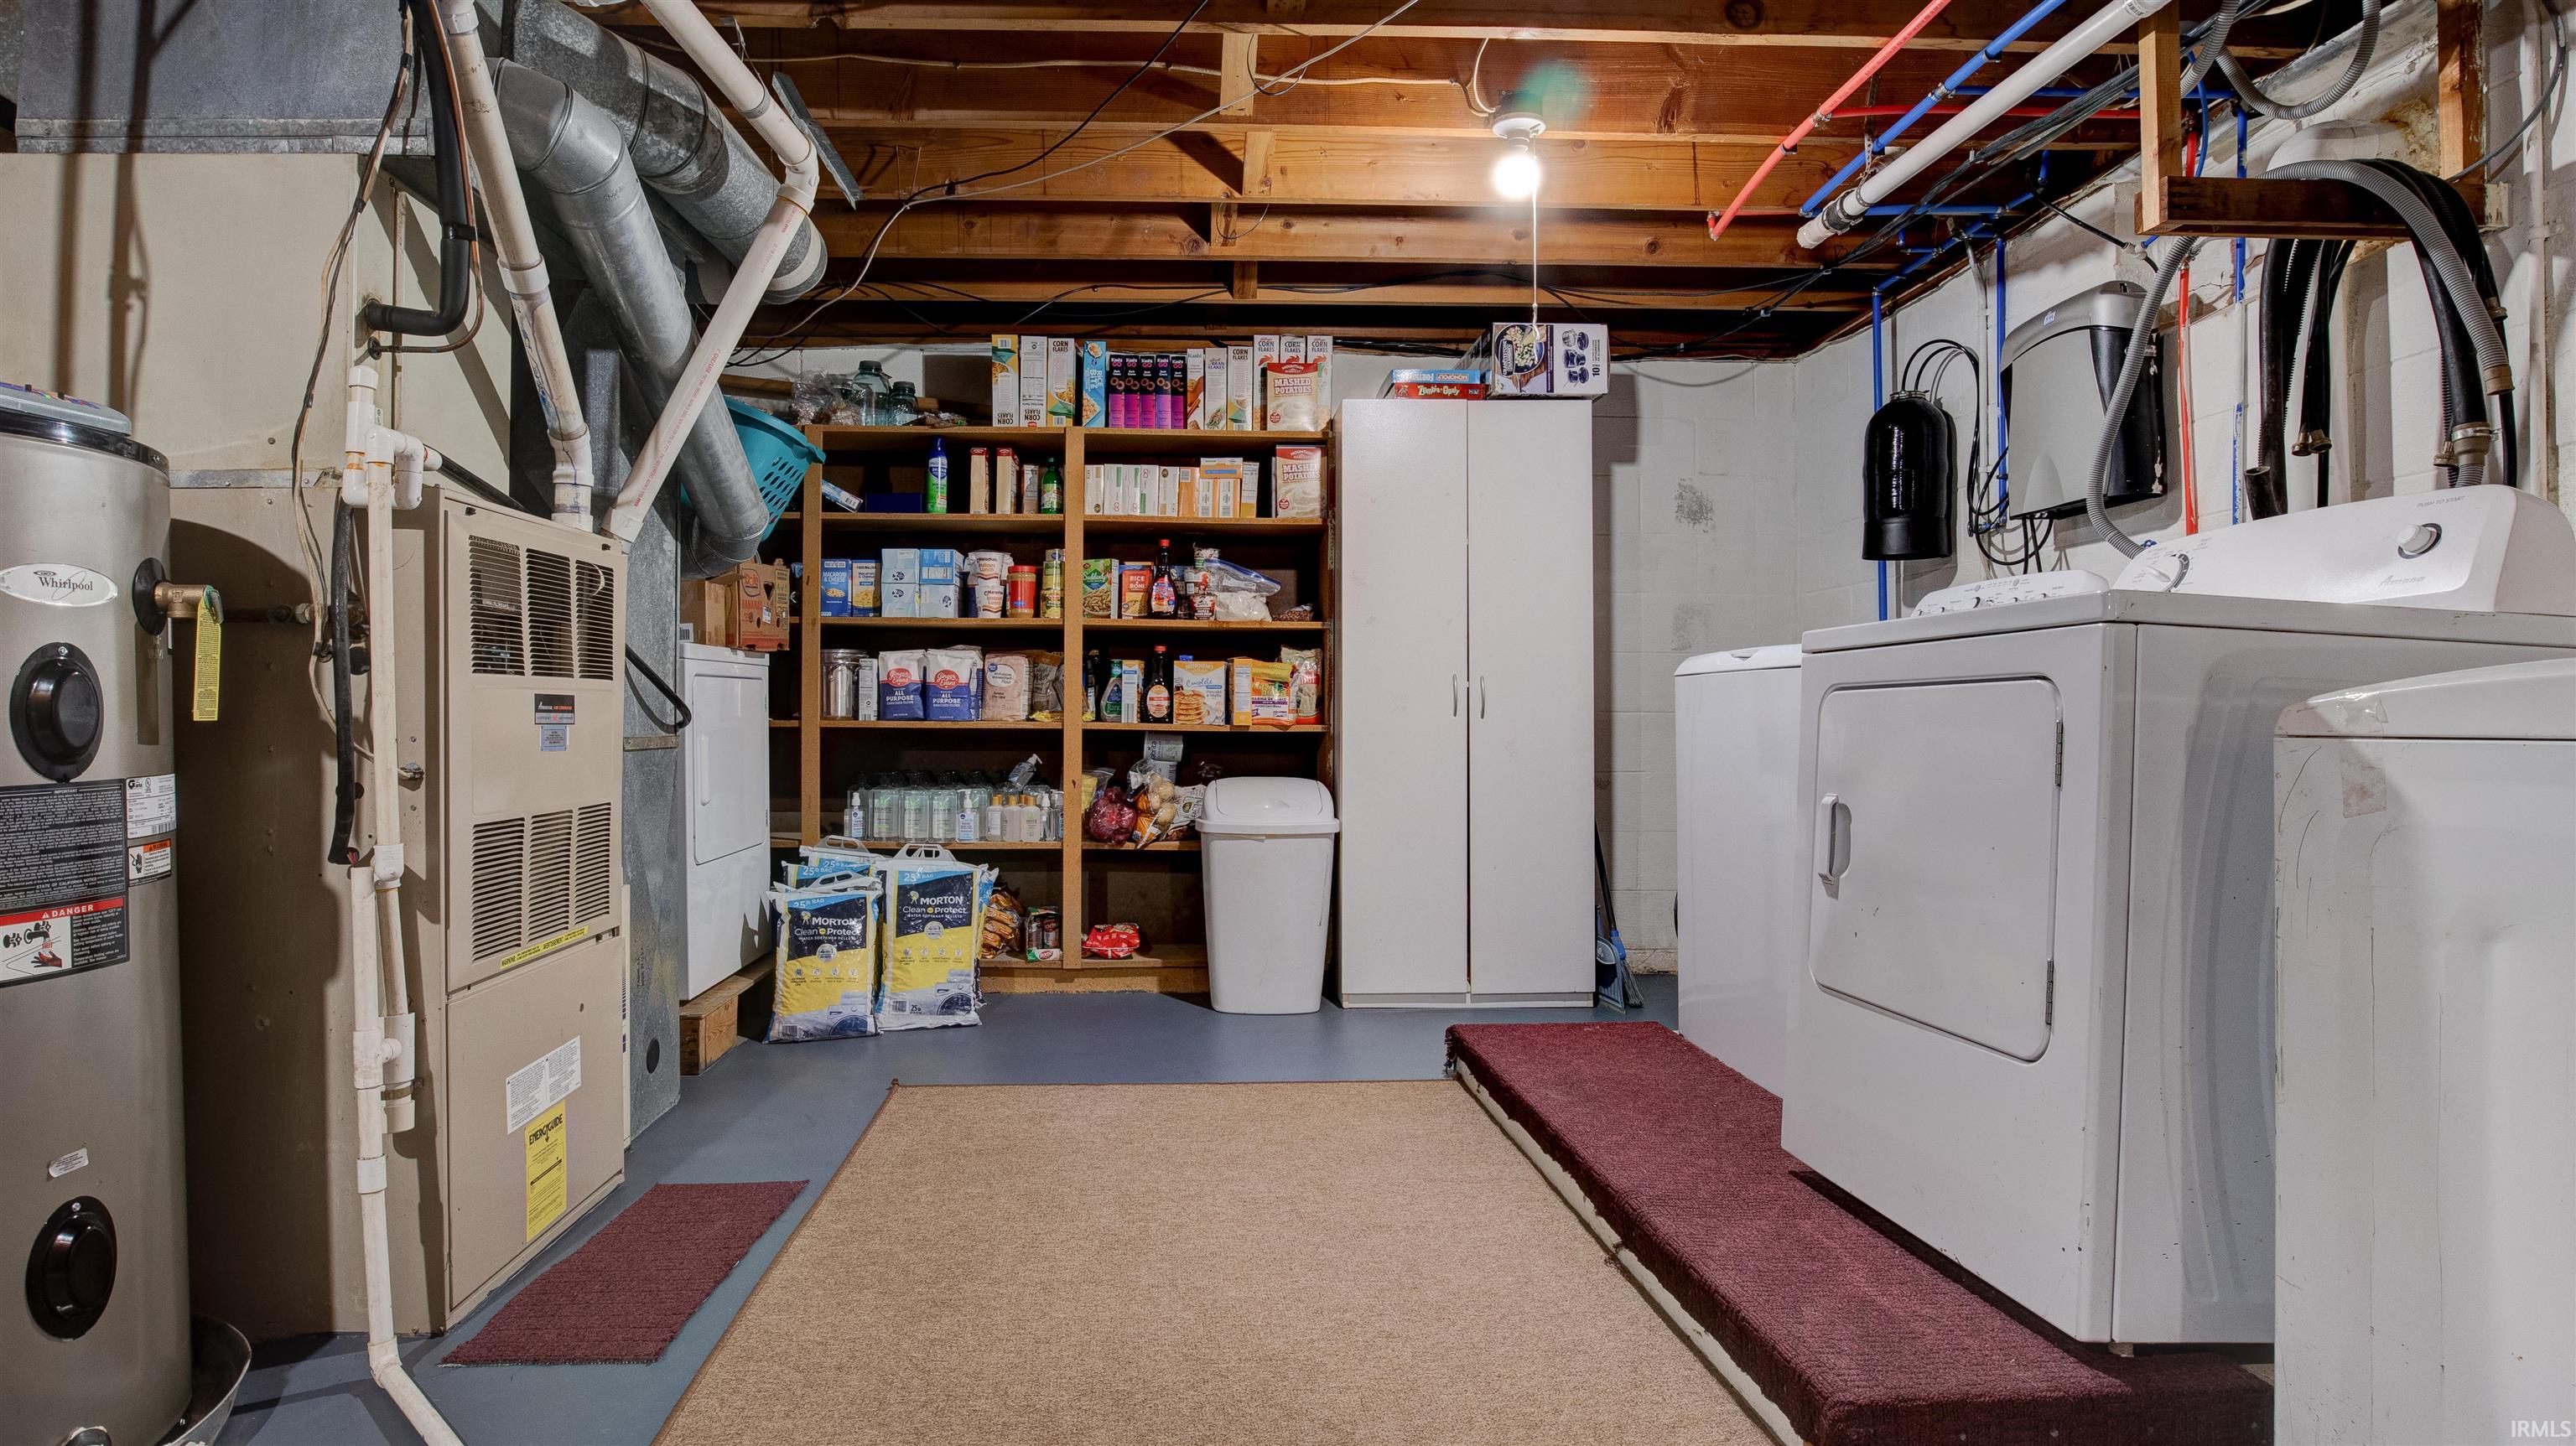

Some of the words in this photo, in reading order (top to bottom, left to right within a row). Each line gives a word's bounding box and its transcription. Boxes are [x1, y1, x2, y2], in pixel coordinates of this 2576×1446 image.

[1592, 367, 1600, 377] 10
[1275, 377, 1311, 386] MASHED
[1282, 463, 1320, 472] MASHED
[1283, 472, 1321, 480] POTATOES
[2445, 495, 2465, 504] START
[39, 576, 93, 592] Whirlpool
[2378, 575, 2426, 588] Amana
[802, 867, 815, 875] 25
[904, 873, 916, 882] 25
[920, 896, 963, 905] MORTON
[51, 904, 94, 917] DANGER
[812, 917, 857, 925] MORTON
[528, 1113, 563, 1146] ENERGYGUIDE
